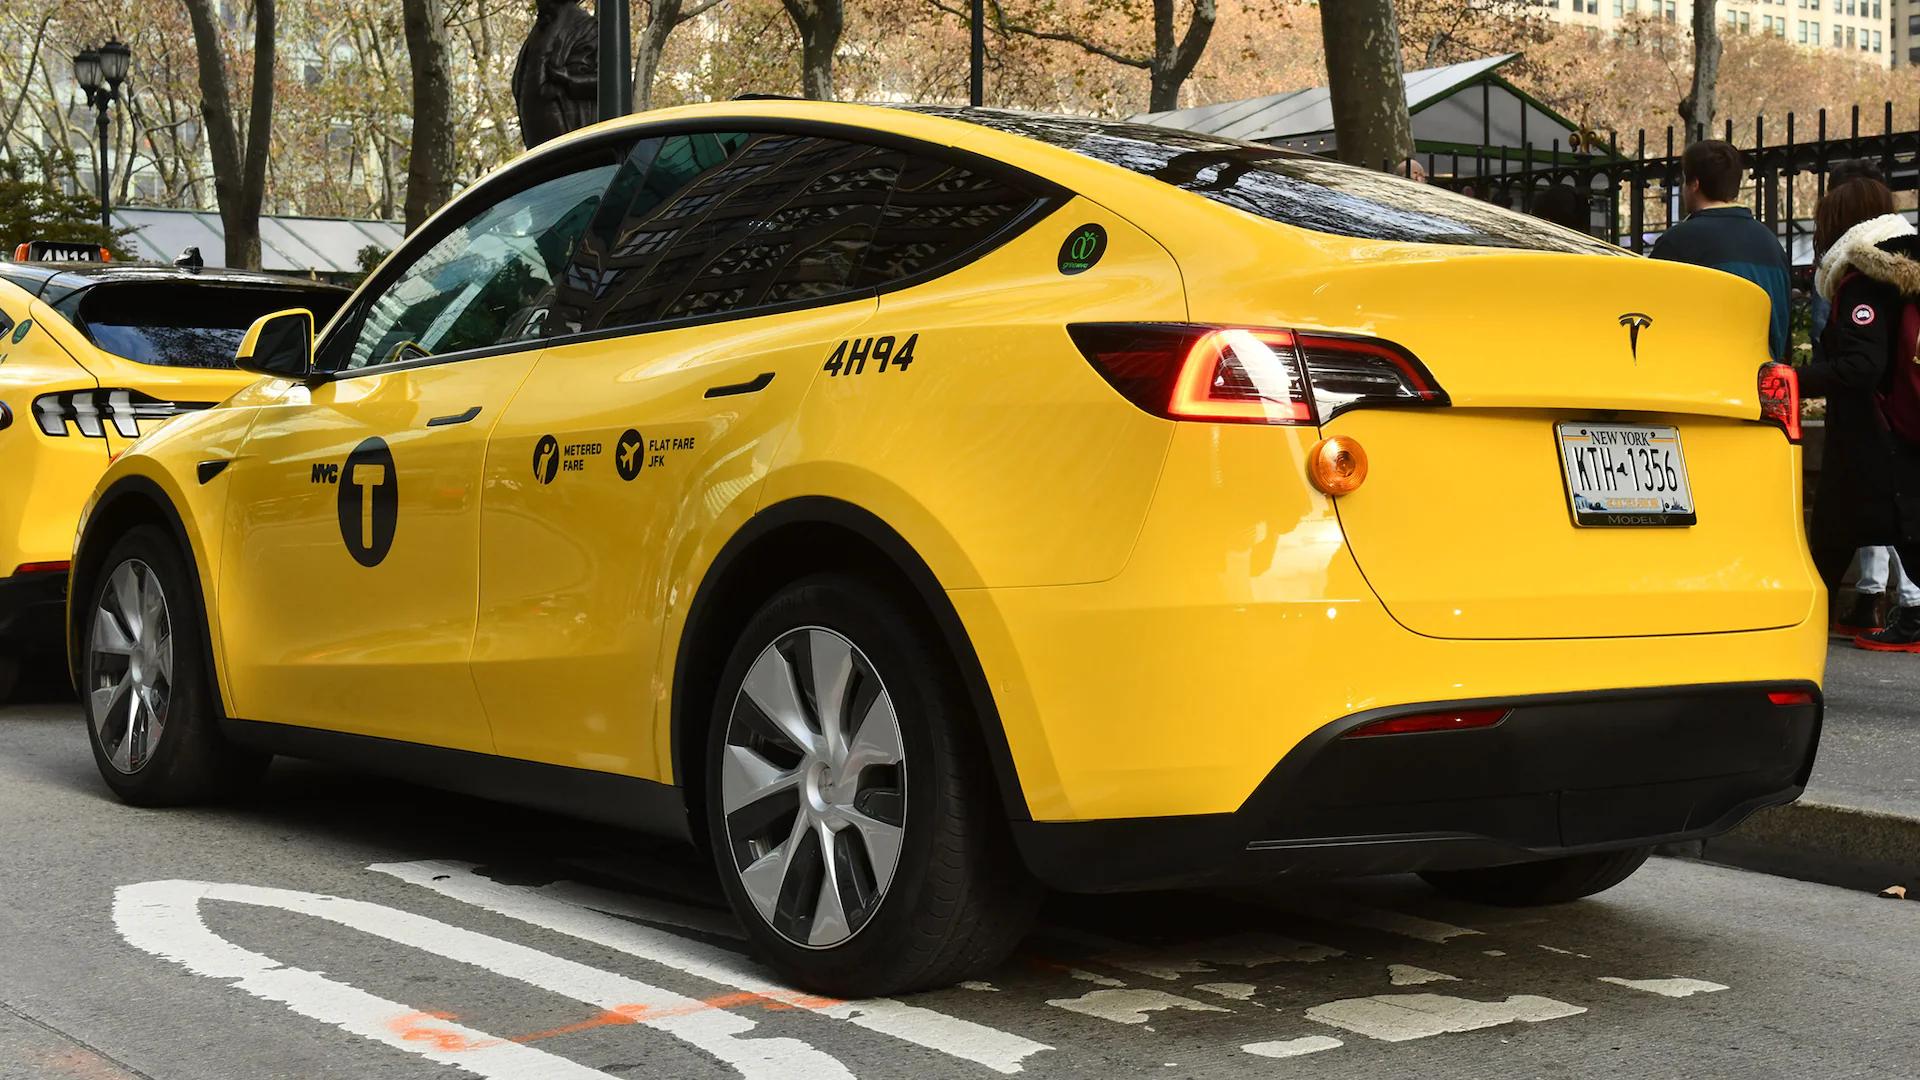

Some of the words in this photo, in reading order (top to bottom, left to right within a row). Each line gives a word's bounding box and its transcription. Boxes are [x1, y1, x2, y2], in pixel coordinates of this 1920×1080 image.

[823, 333, 919, 377] 4H94
[649, 439, 670, 452] FLAT
[672, 437, 695, 450] FARE
[1591, 431, 1617, 445] NEW
[1619, 432, 1650, 446] YORK
[564, 443, 602, 456] METERED
[563, 459, 584, 471] FARE
[648, 455, 665, 467] JFK
[1574, 446, 1618, 491] KTH
[311, 463, 338, 484] NYC
[352, 463, 385, 549] T
[1608, 515, 1657, 525] MODEL
[1661, 515, 1669, 525] Y
